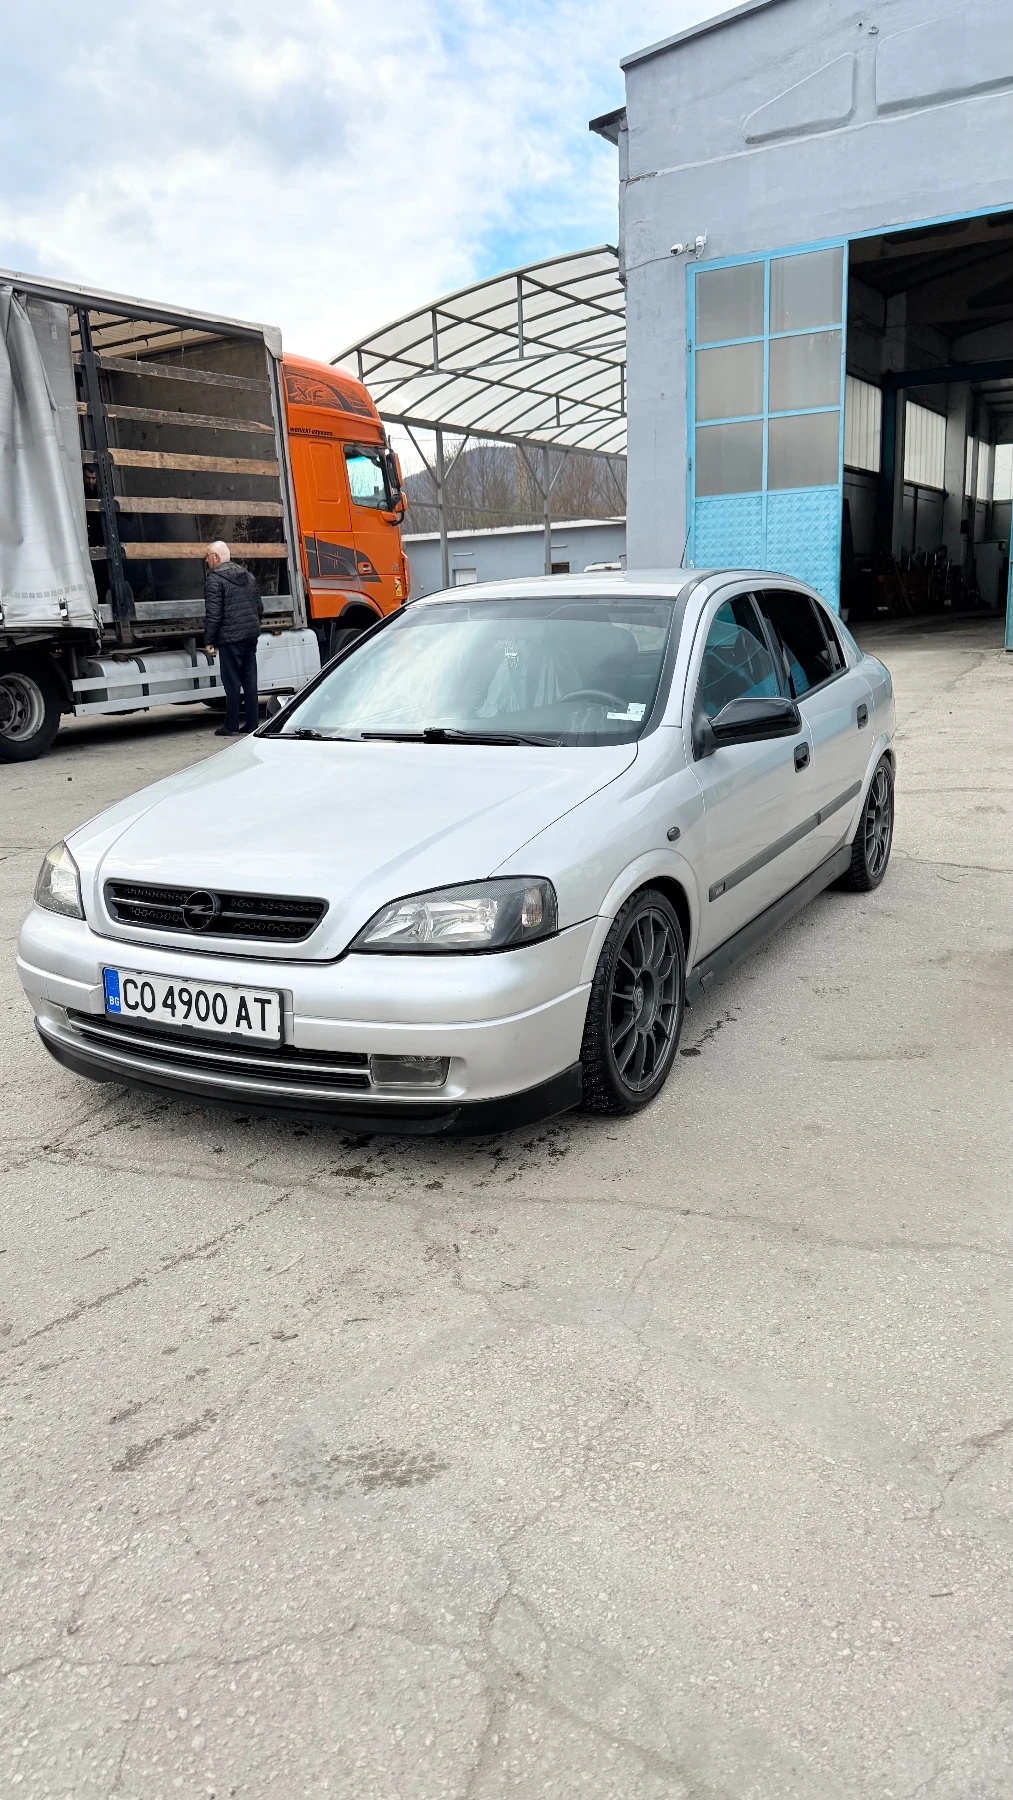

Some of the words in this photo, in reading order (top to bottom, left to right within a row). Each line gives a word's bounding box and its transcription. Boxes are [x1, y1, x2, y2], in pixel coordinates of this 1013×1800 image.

[296, 386, 323, 401] XF
[109, 995, 120, 1006] BG
[122, 978, 156, 1013] CO
[162, 985, 228, 1025] 4900
[235, 995, 272, 1032] AT
